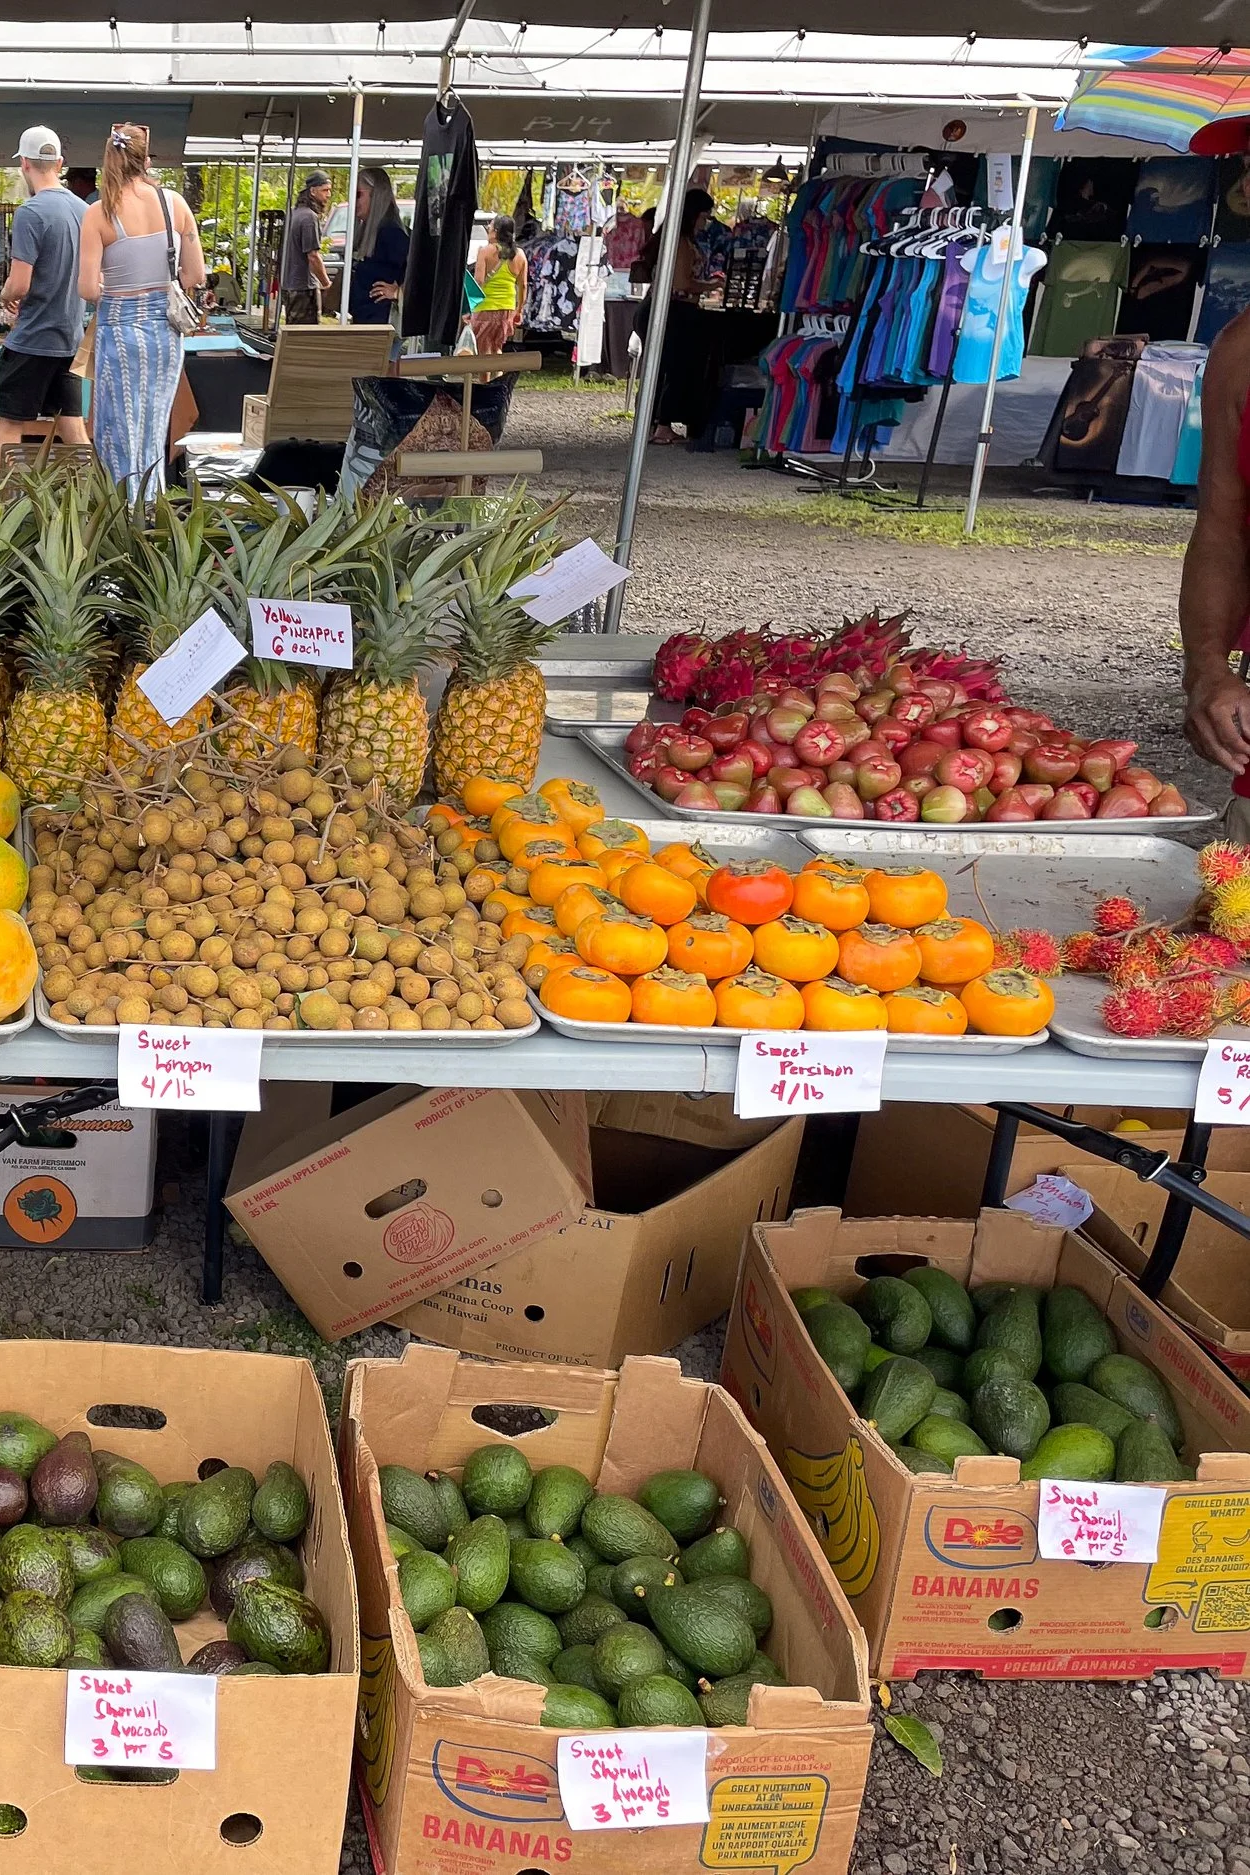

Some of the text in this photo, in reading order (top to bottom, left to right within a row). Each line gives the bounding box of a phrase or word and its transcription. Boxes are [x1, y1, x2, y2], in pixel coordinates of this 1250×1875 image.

[280, 625, 345, 643] PINEAPPLE
[272, 636, 321, 656] 6 each
[138, 1030, 191, 1051] Sweet
[756, 1041, 809, 1057] Sweet
[429, 1088, 458, 1108] STORE
[414, 1097, 466, 1130] PRODUCT OF
[41, 1159, 86, 1167] PERSIMMON
[253, 1177, 292, 1202] HAWAIIAN
[293, 1163, 319, 1183] APPLE
[317, 1146, 351, 1169] BANANA
[248, 1207, 260, 1219] 35
[386, 1236, 488, 1291] www.applebananas.com
[358, 1300, 391, 1318] BANANA
[391, 1288, 414, 1305] FARM
[481, 1298, 514, 1316] Coop
[446, 1304, 488, 1323] Hawaii
[495, 1342, 547, 1360] PRODUCT
[548, 1353, 563, 1362] OF
[1158, 1336, 1239, 1425] CONSUMER PACK
[1185, 1499, 1222, 1509] GRILLED
[943, 1518, 1024, 1546] Dole
[1110, 1543, 1124, 1557] 5
[1185, 1555, 1244, 1564] DES BANANES
[911, 1575, 1040, 1599] BANANAS
[1003, 1659, 1136, 1673] PREMIUM BANANAS
[91, 1738, 109, 1757] 3
[158, 1741, 174, 1760] 5
[714, 1754, 816, 1765] PRODUCT OF ECUADOR
[456, 1756, 550, 1794] Dole
[731, 1782, 812, 1793] GREAT NUTRITION
[756, 1793, 783, 1802] AT AN
[591, 1803, 612, 1823] 3
[657, 1800, 671, 1818] 5
[721, 1803, 779, 1812] UNBEATABLE
[721, 1820, 807, 1831] UN ALIMENT RICHE
[422, 1814, 573, 1862] BANANAS
[712, 1841, 726, 1850] UN
[728, 1840, 769, 1850] RAPPORT
[720, 1832, 732, 1841] EN
[717, 1851, 738, 1859] PRIX
